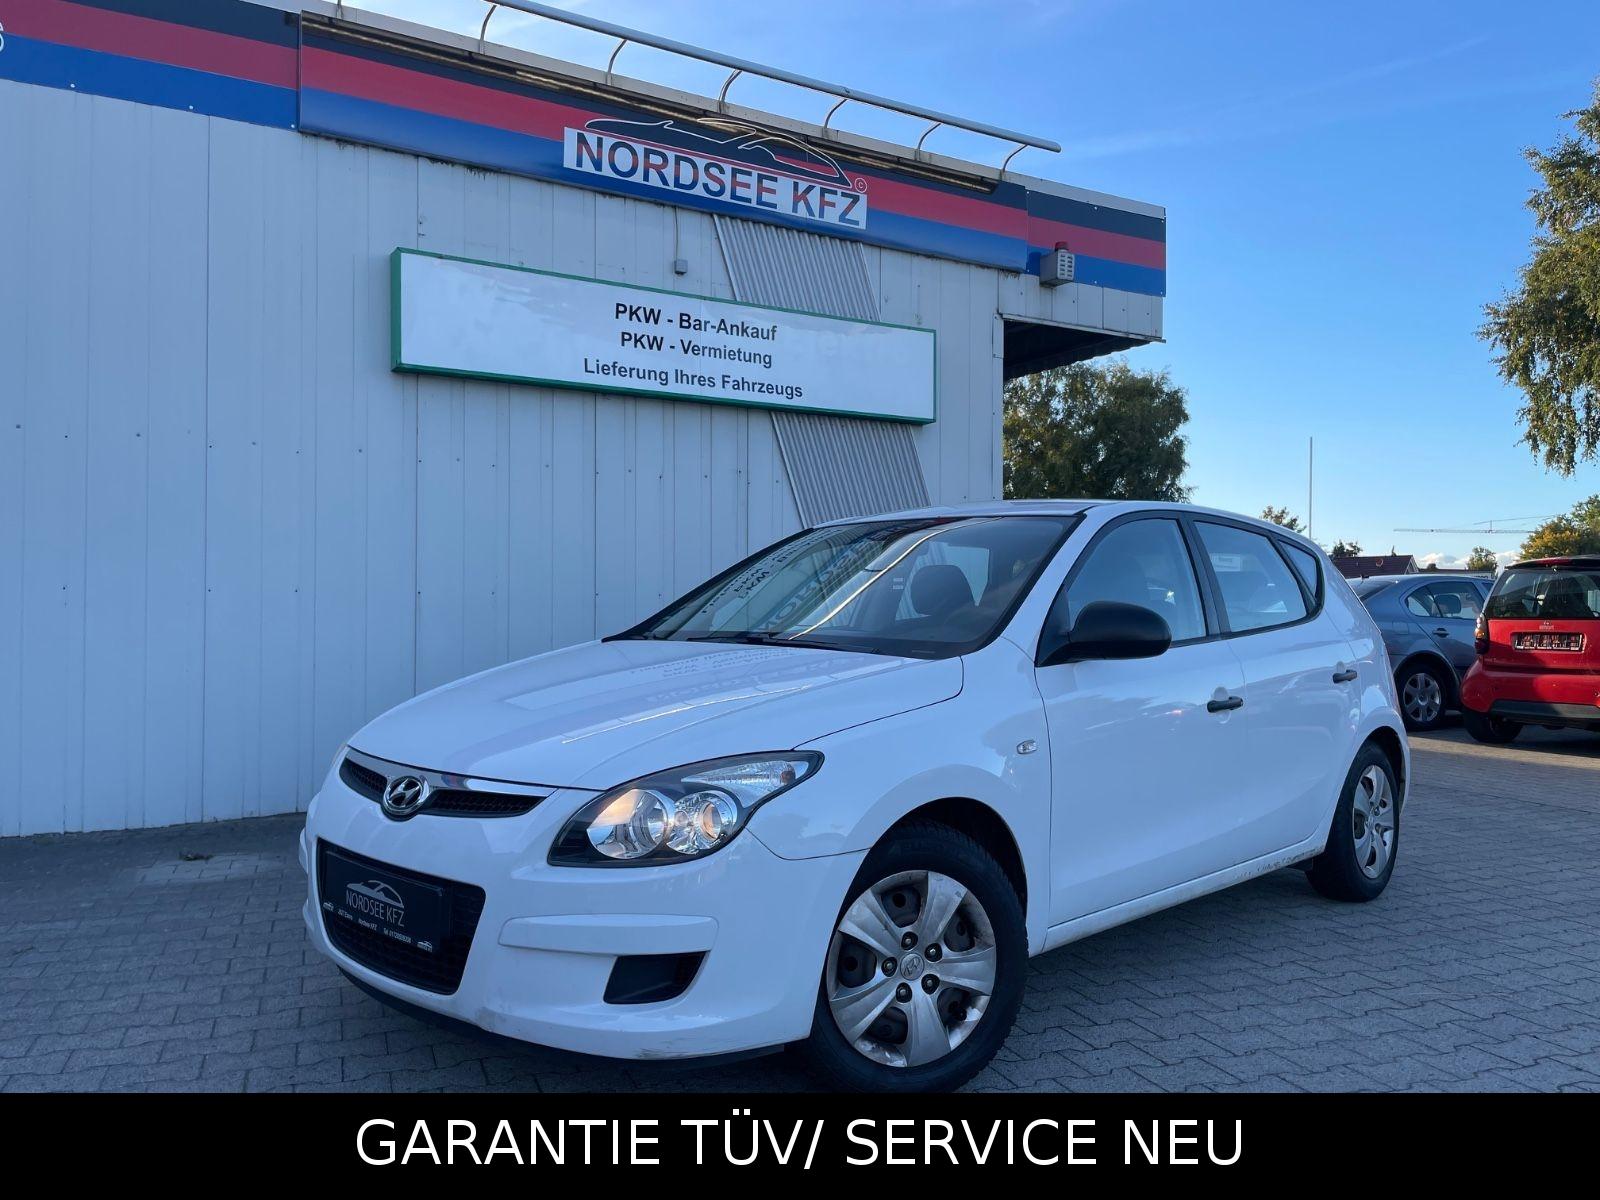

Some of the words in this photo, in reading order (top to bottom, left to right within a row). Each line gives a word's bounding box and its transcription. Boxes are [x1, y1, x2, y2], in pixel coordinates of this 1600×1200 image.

[576, 131, 779, 210] NORDSEE
[791, 180, 861, 226] KFZ
[615, 302, 662, 326] PKW
[679, 313, 778, 341] Bar-Ankauf
[621, 331, 664, 352] PKW
[681, 339, 772, 369] Vermietung
[584, 358, 669, 386] Lieferung
[674, 369, 716, 388] Ihres
[722, 375, 803, 400] Fahrzeugs
[345, 889, 385, 920] NORDSEE
[386, 907, 405, 927] KFZ
